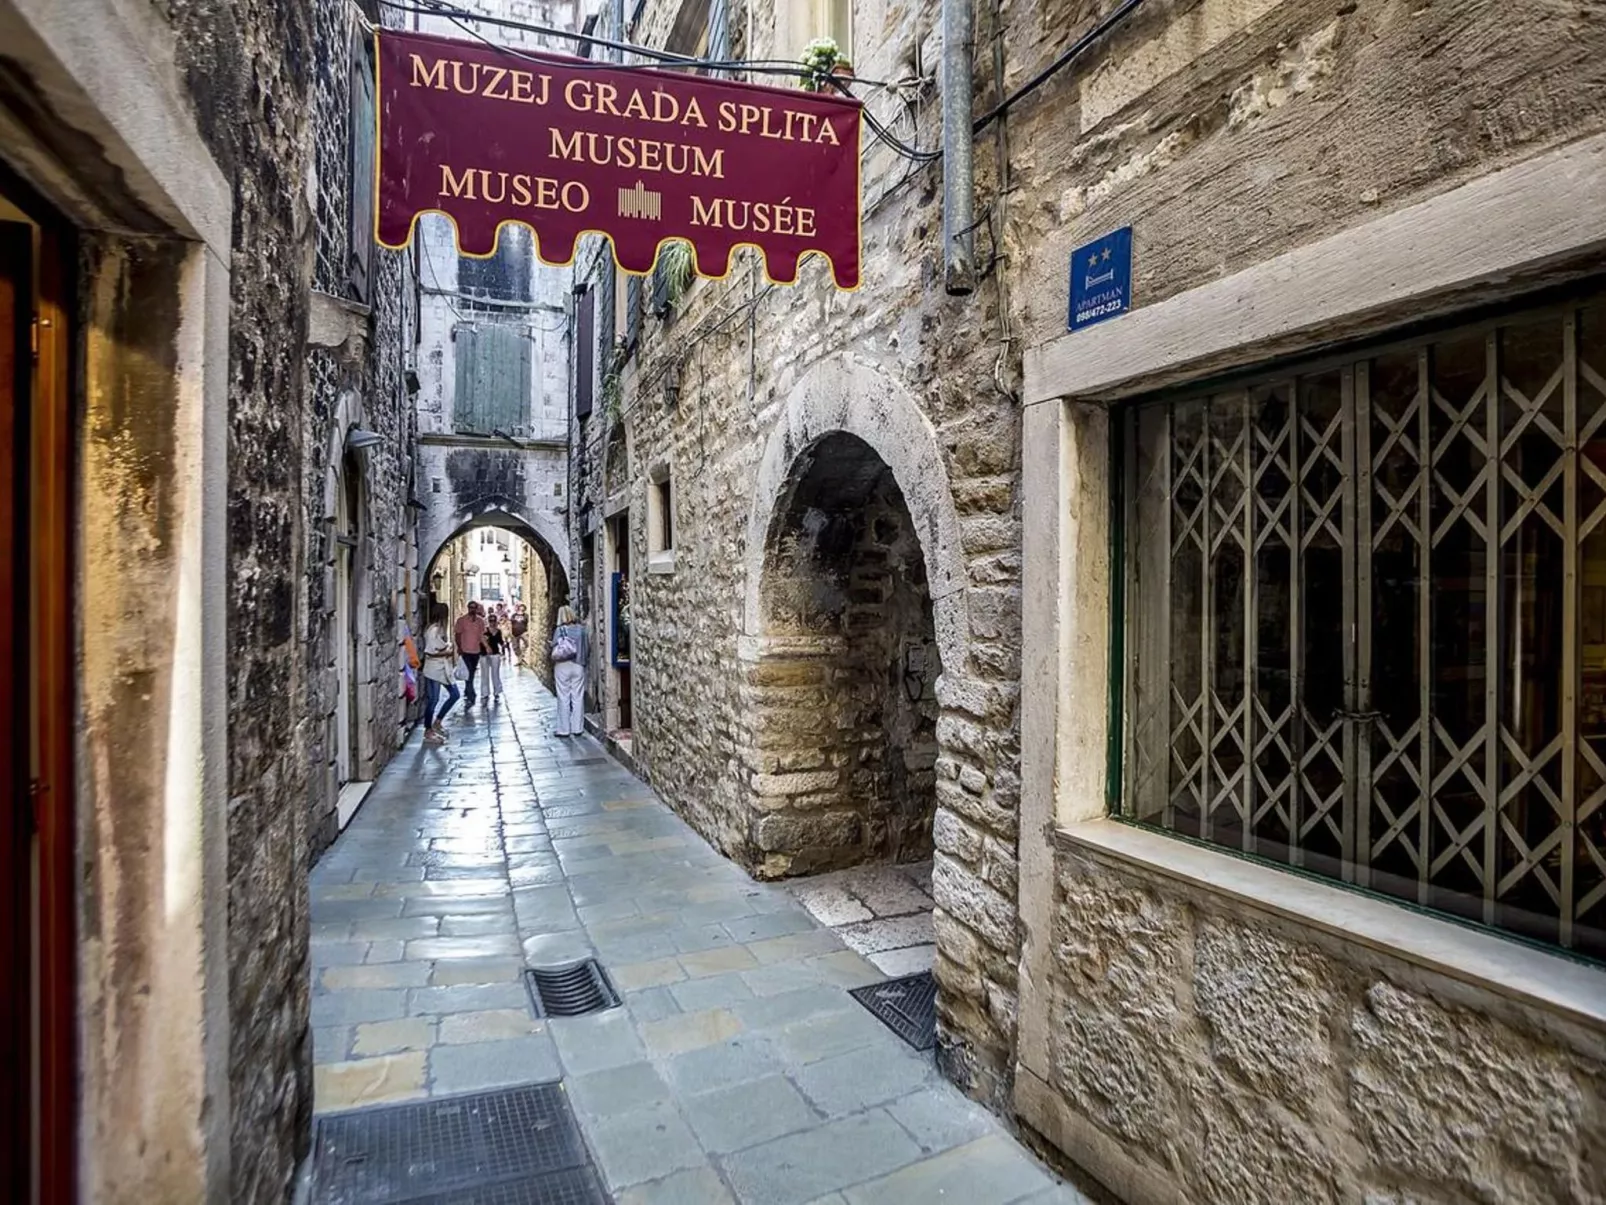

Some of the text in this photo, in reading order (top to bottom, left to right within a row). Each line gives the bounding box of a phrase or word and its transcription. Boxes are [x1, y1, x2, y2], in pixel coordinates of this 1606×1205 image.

[409, 53, 840, 146] MUZEJ GRADA SPLITA
[548, 127, 725, 179] MUSEUM
[438, 164, 817, 237] MUSEO MUSÉE
[1076, 286, 1123, 312] APARTMAN
